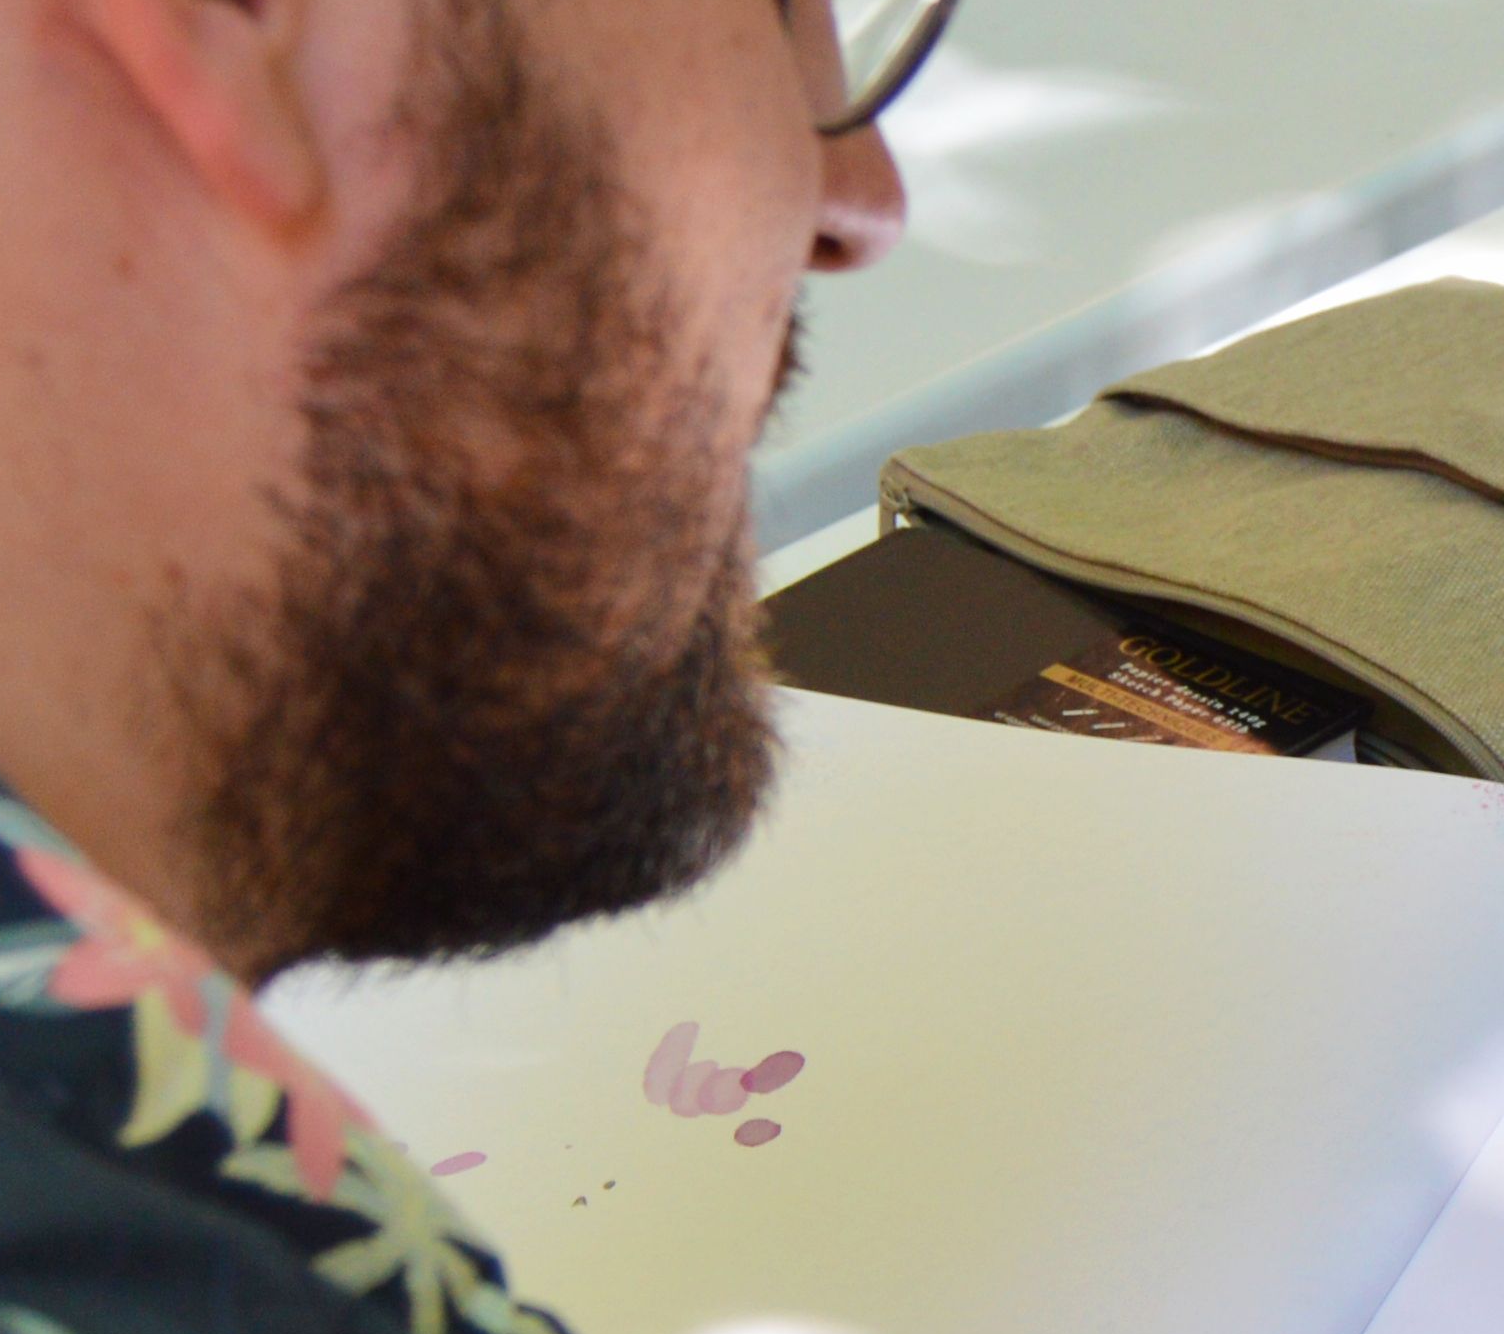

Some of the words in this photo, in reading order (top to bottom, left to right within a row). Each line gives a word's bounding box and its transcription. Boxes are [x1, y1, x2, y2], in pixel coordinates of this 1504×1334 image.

[1107, 671, 1162, 697] Sketch
[1118, 634, 1314, 724] GOLDLINE
[1119, 661, 1172, 688] Papier
[1173, 683, 1224, 710] dessin
